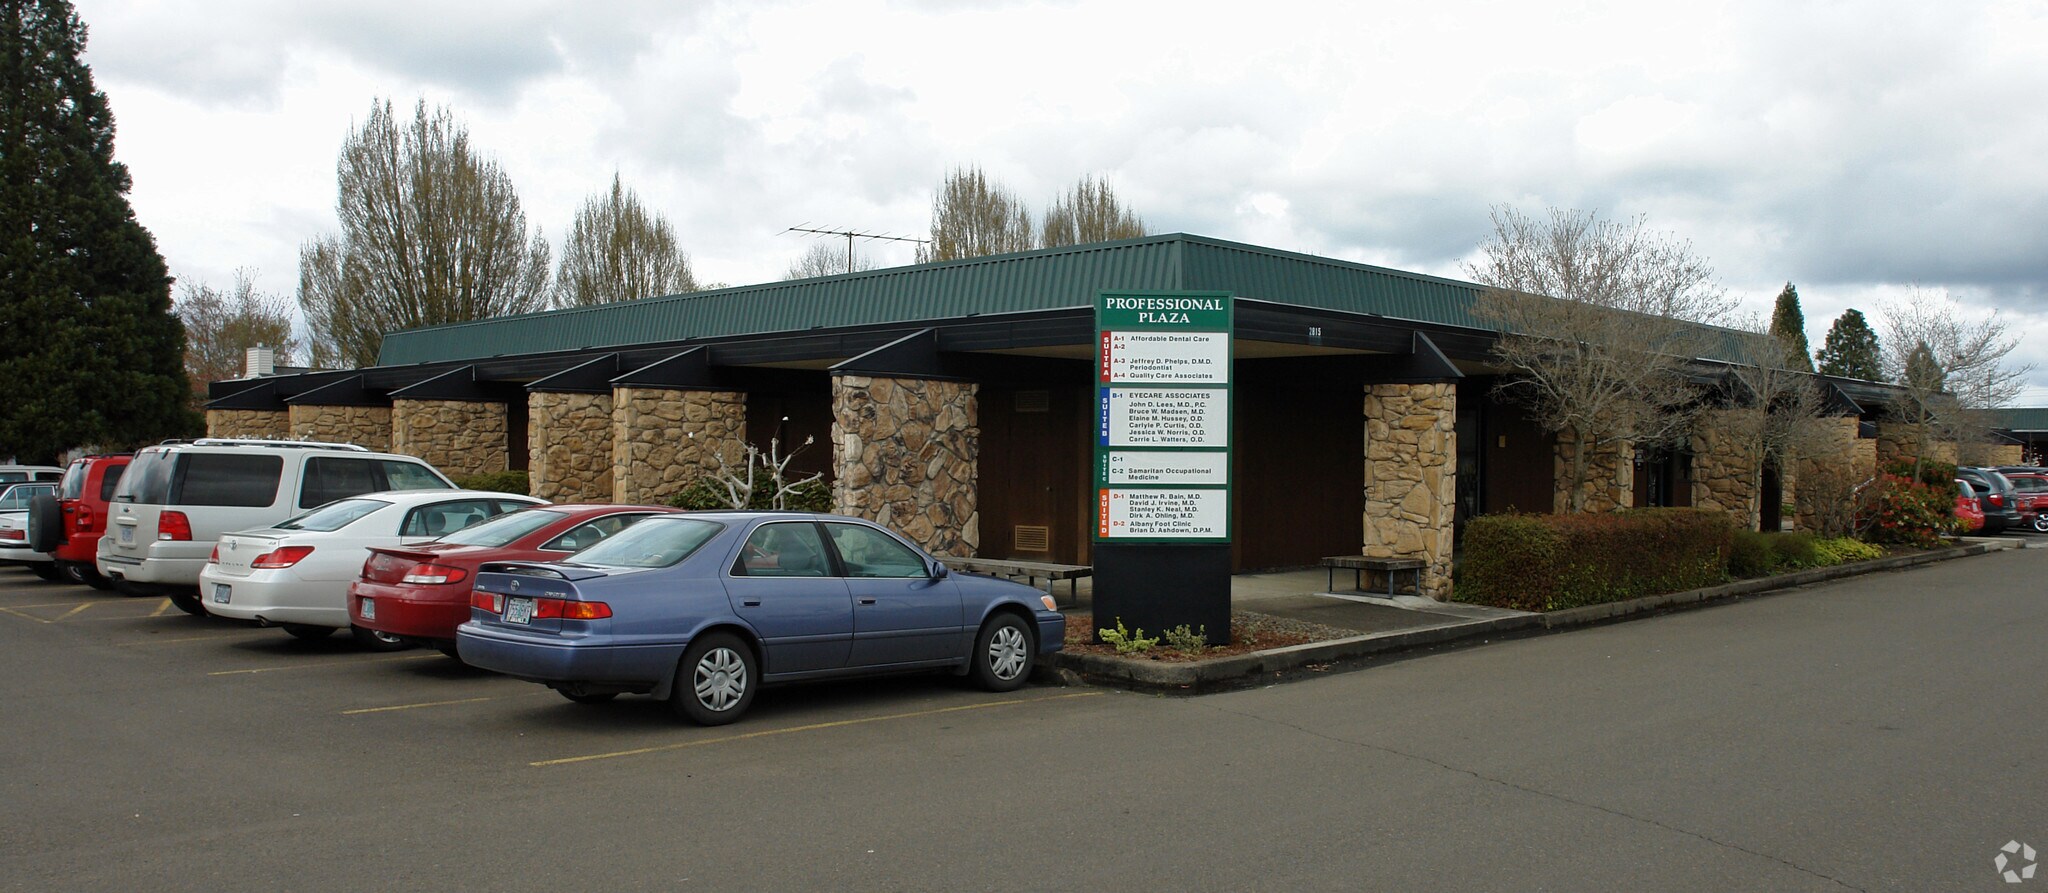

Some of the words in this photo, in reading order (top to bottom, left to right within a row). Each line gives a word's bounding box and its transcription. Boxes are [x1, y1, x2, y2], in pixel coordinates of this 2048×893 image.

[1106, 297, 1224, 311] PROFESSIONAL
[1138, 312, 1190, 323] PLAZA
[1130, 358, 1154, 366] Jeffrey
